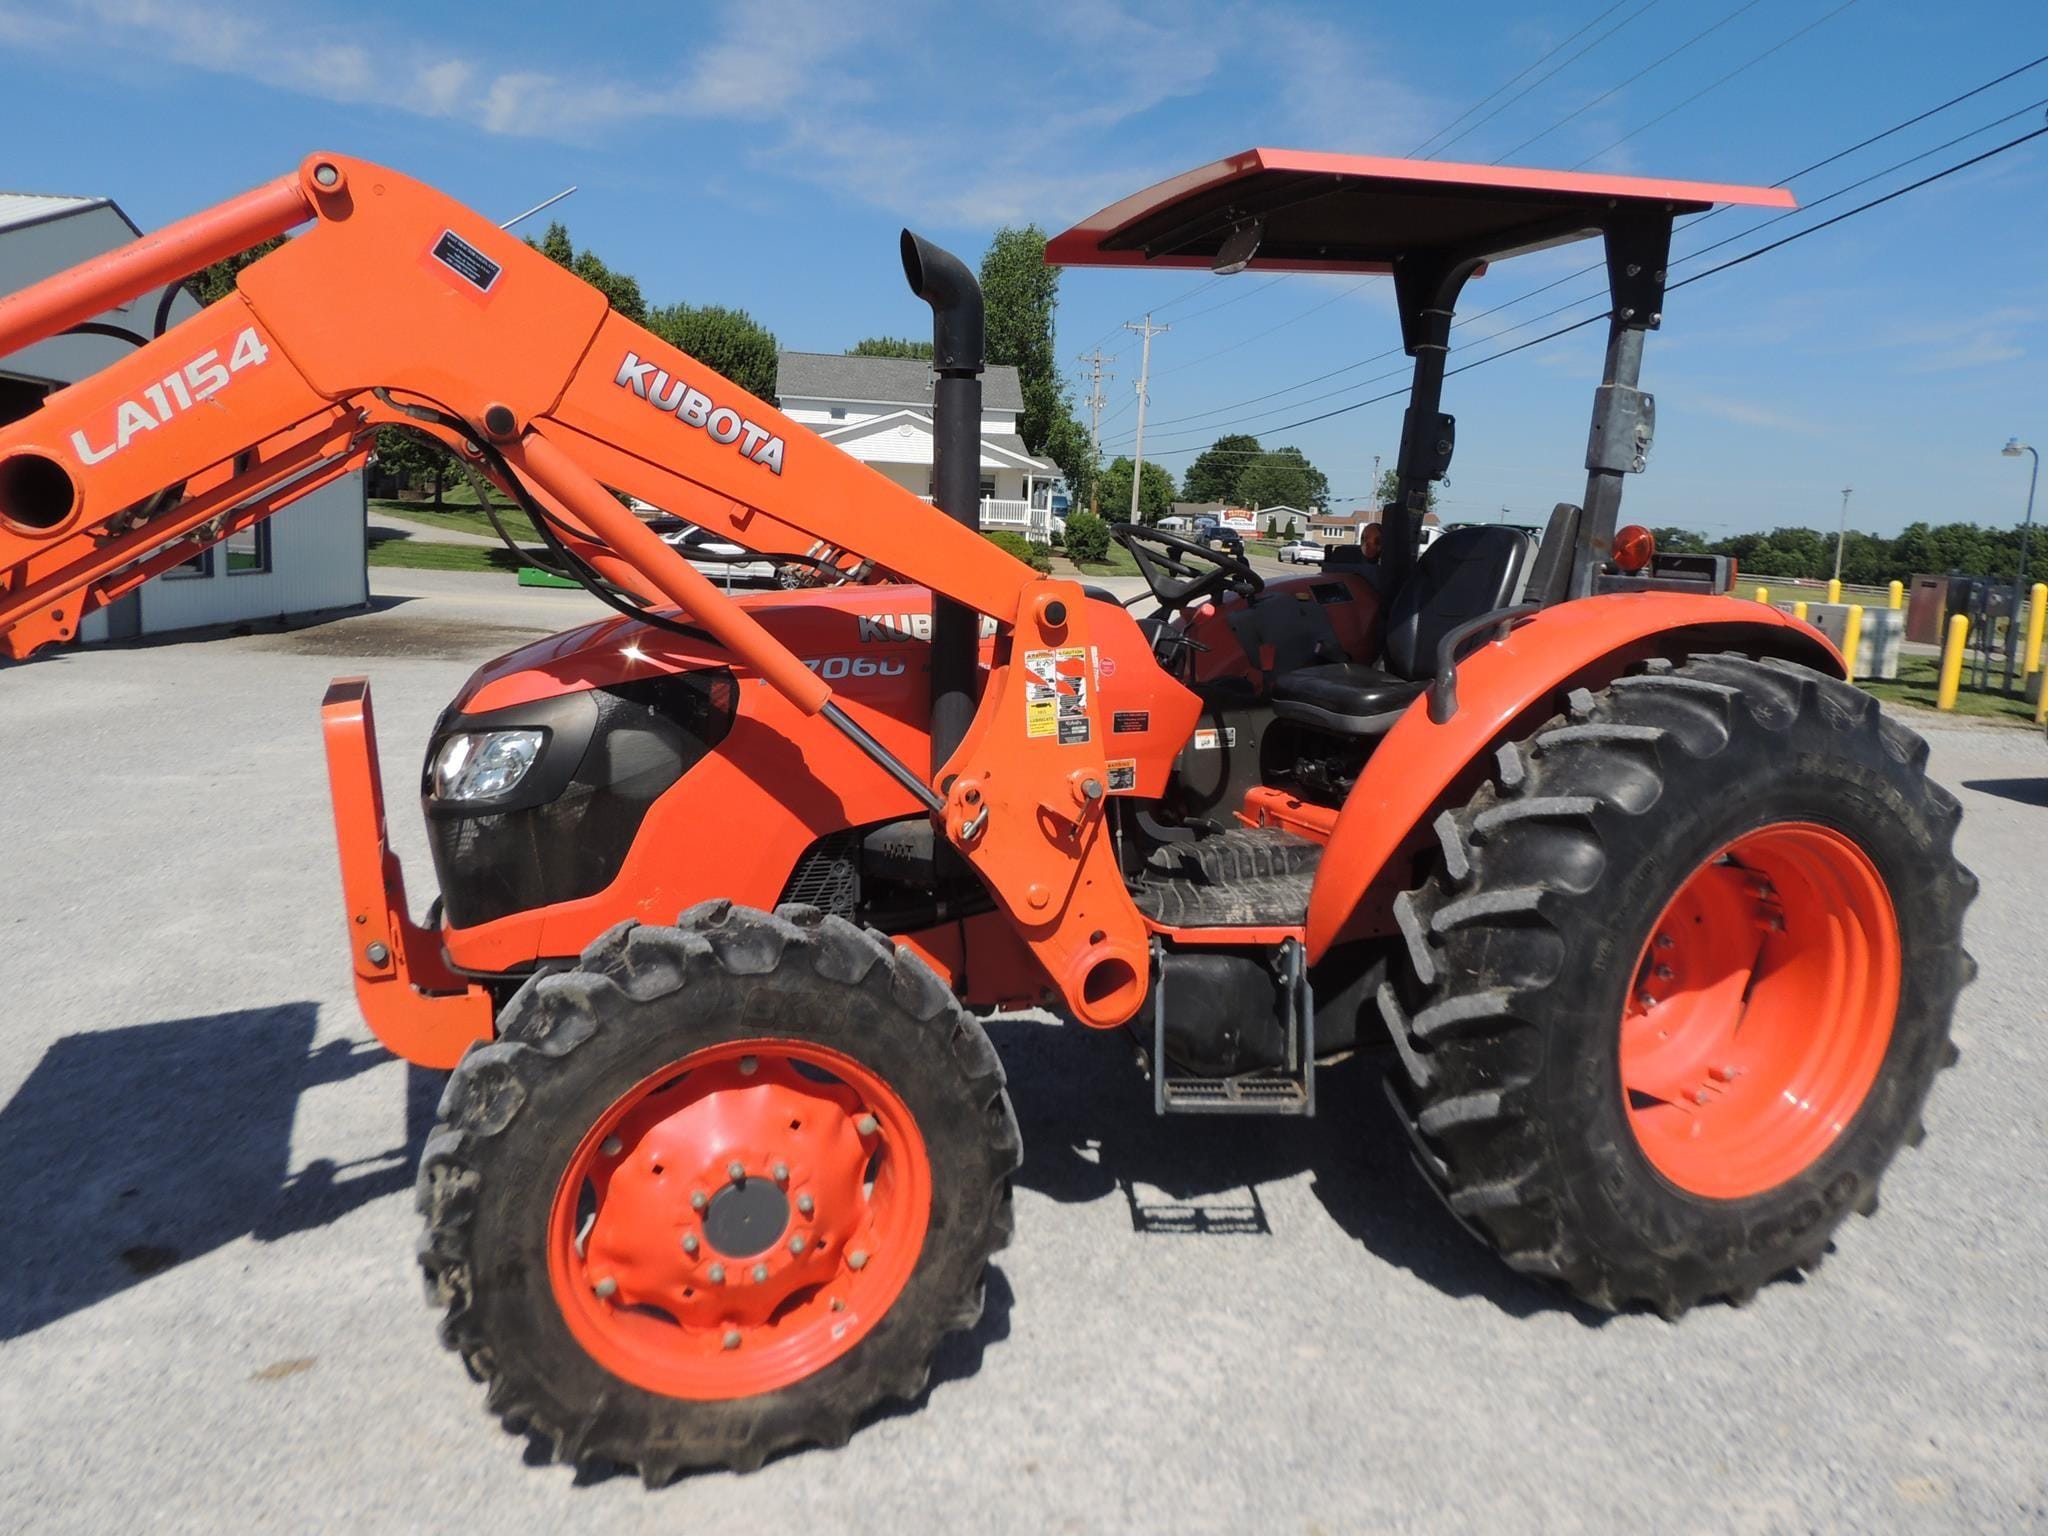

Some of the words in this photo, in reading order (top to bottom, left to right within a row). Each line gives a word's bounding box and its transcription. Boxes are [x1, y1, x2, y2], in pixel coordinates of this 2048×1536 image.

[70, 327, 269, 465] LA1154
[614, 351, 785, 476] KUBOTA
[858, 614, 998, 642] KUBA
